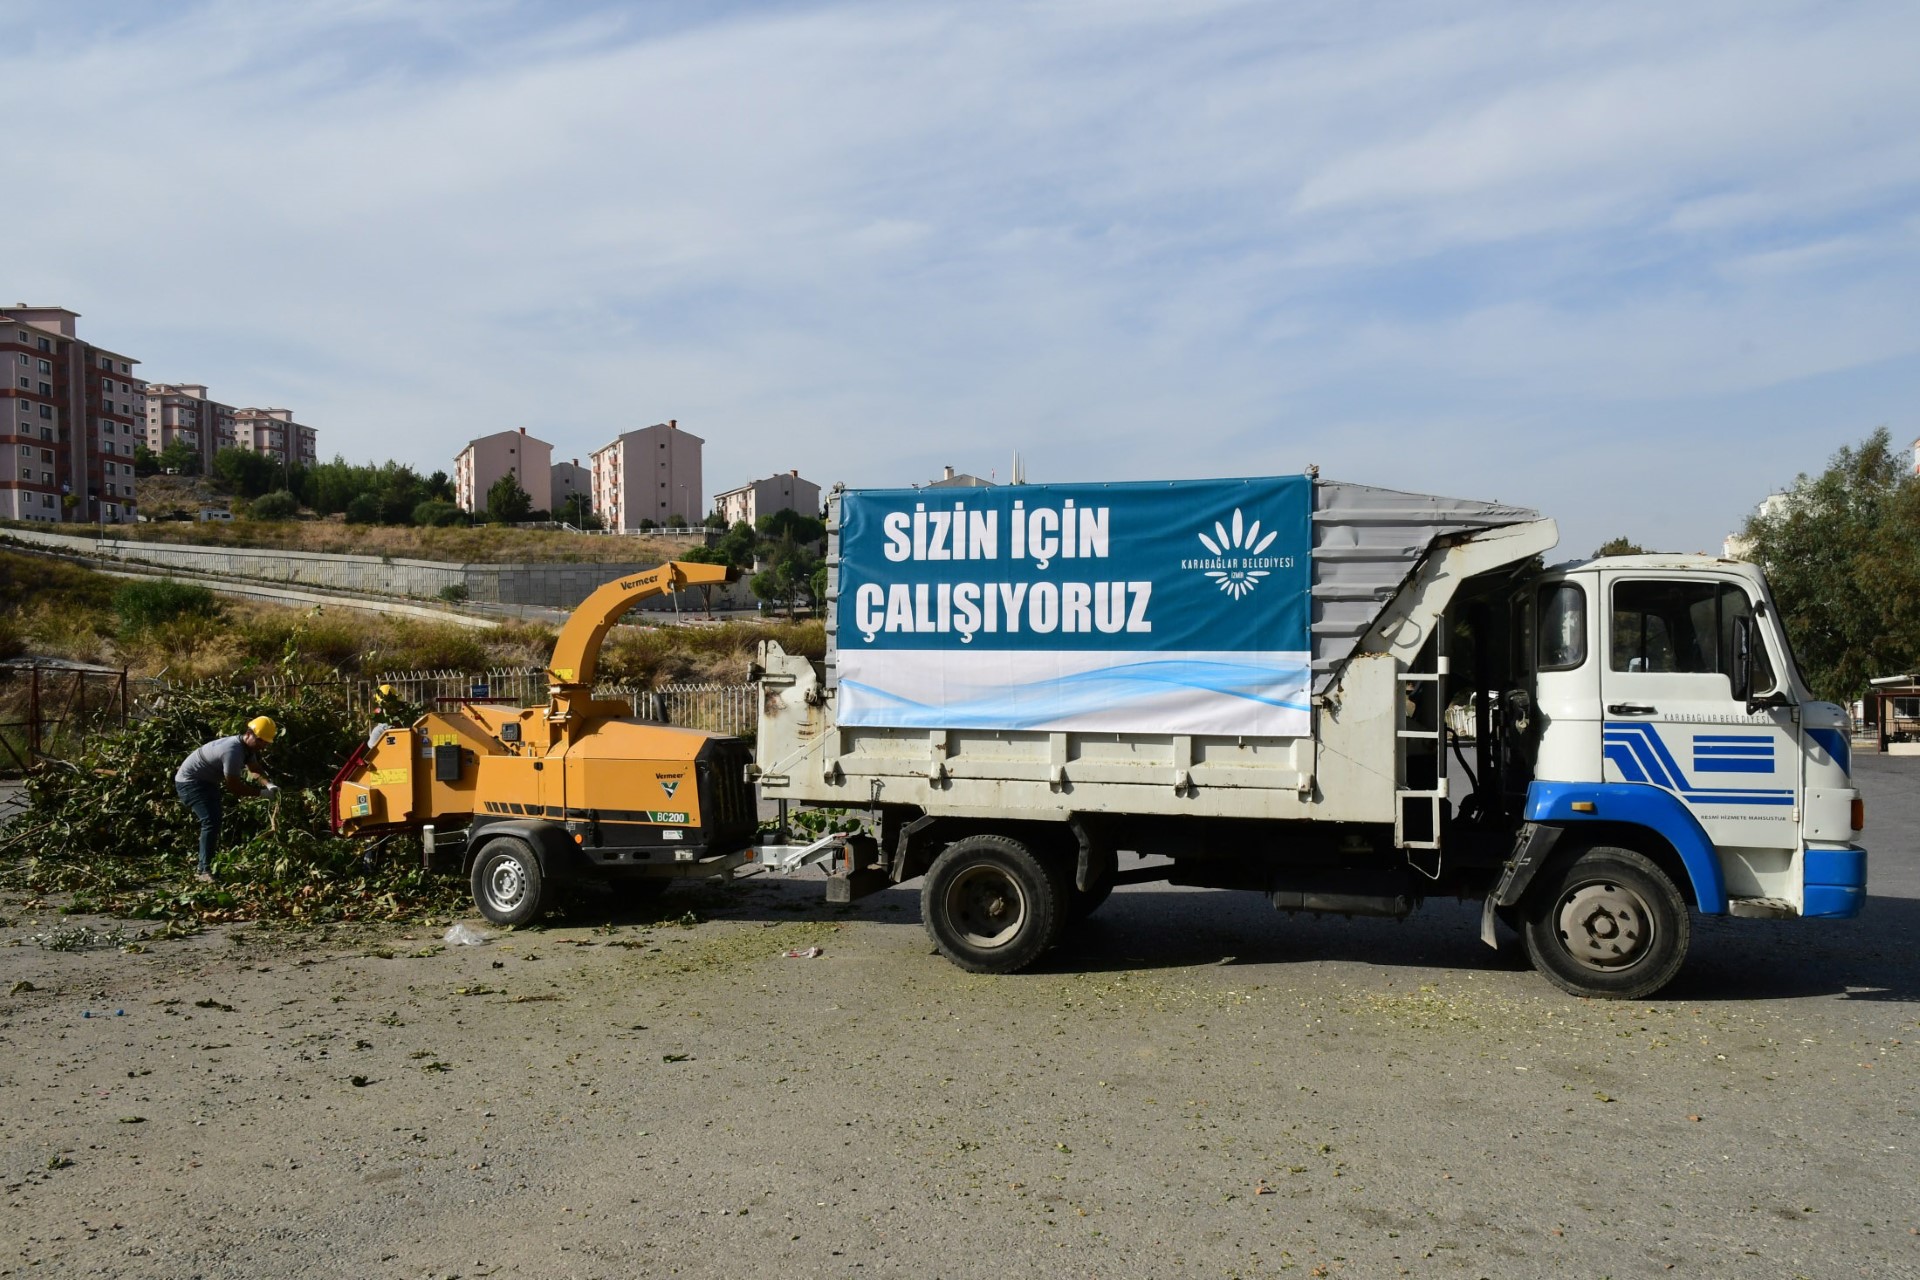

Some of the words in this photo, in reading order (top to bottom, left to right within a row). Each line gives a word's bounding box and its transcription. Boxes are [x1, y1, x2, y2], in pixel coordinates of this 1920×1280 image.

[883, 502, 998, 562] SİZİN
[1011, 498, 1110, 569] İÇİN
[1181, 557, 1238, 569] KARABAĞLAR
[1242, 555, 1294, 568] BELEDİYESİ
[620, 575, 658, 590] Vermeer
[855, 581, 1152, 643] ÇALIŞIYORUZ
[656, 772, 684, 780] Vermeer
[657, 812, 685, 823] BC200
